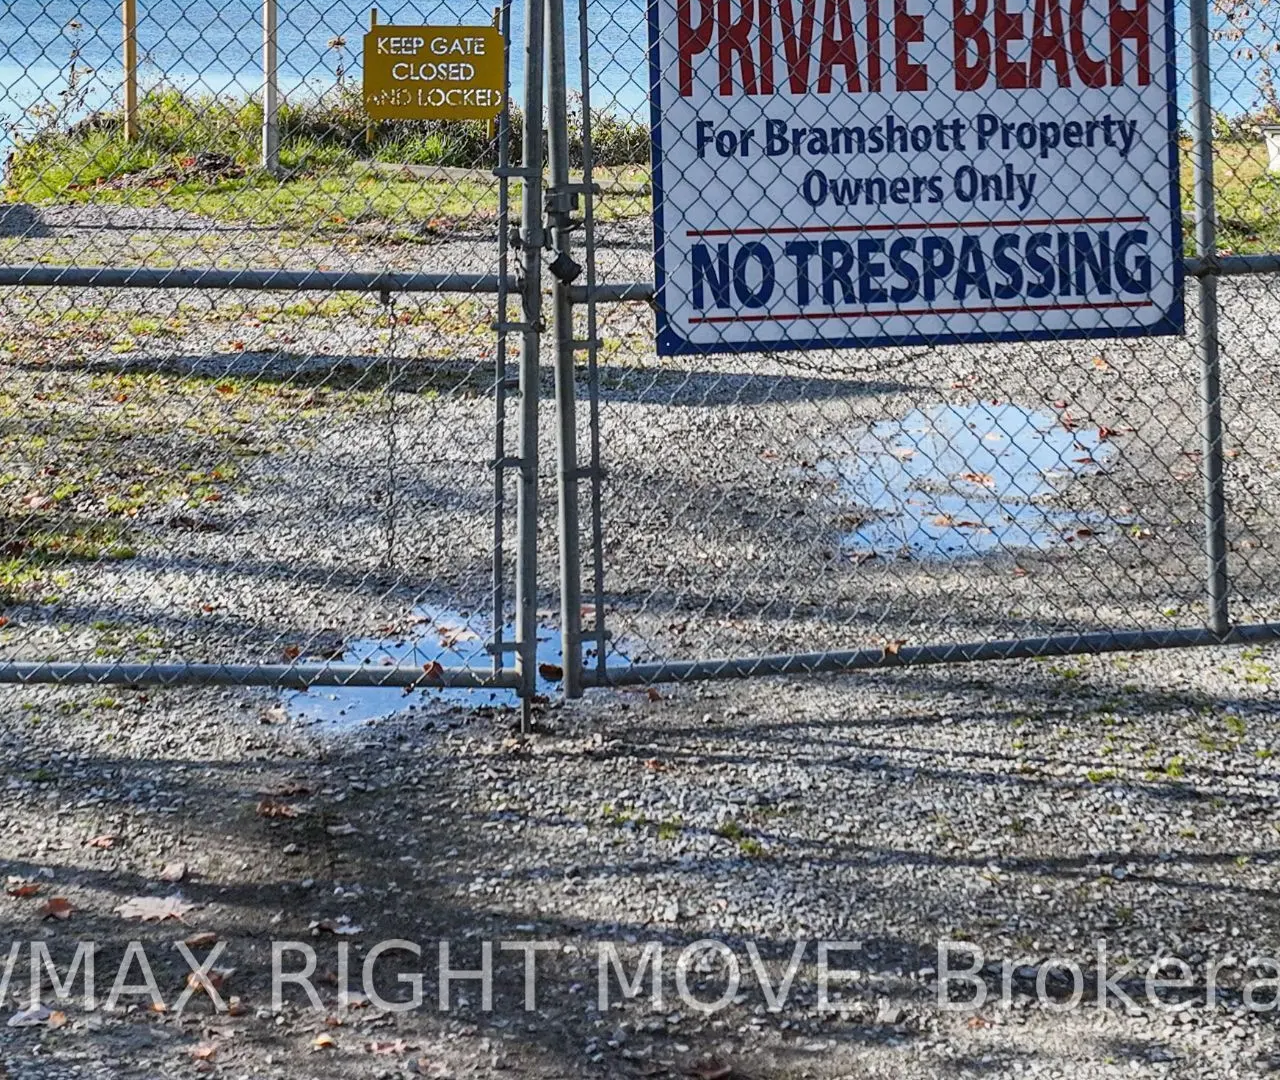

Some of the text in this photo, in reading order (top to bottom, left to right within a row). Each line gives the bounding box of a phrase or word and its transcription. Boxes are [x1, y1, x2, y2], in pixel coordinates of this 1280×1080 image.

[376, 37, 486, 56] KEEP GATE
[392, 62, 475, 81] CLOSED
[418, 88, 502, 107] LOCKED
[694, 113, 1137, 159] For Bramshott Property
[801, 164, 1037, 211] Owners Only
[689, 229, 1152, 311] NO TRESPASSING
